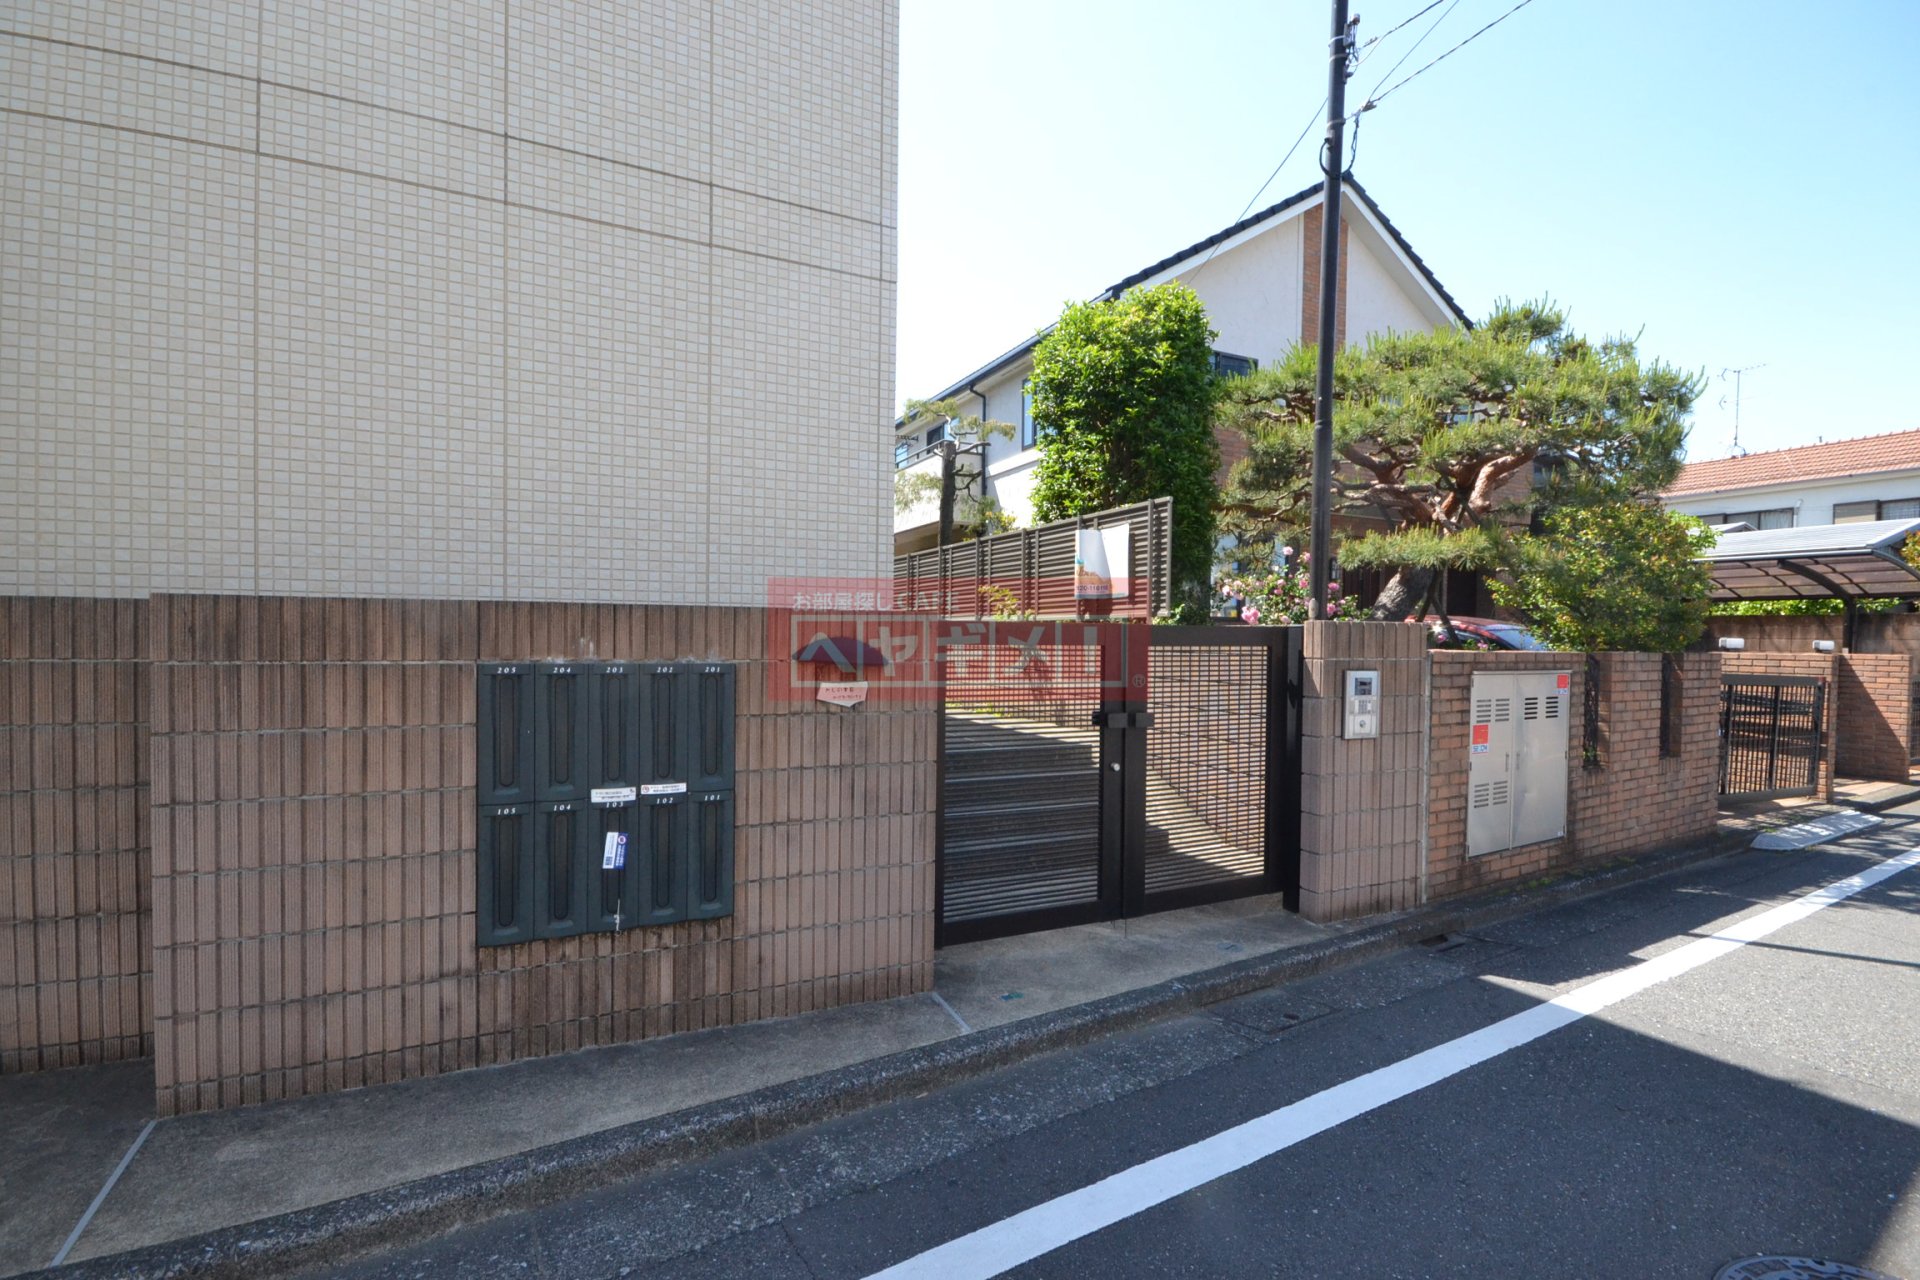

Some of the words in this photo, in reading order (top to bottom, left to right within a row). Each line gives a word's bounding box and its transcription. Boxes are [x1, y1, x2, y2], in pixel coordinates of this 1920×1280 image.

[497, 666, 517, 674] 205
[553, 666, 571, 674] 204
[606, 666, 624, 674] 203
[656, 797, 674, 805] 102
[497, 807, 517, 815] 105
[553, 804, 571, 812] 104
